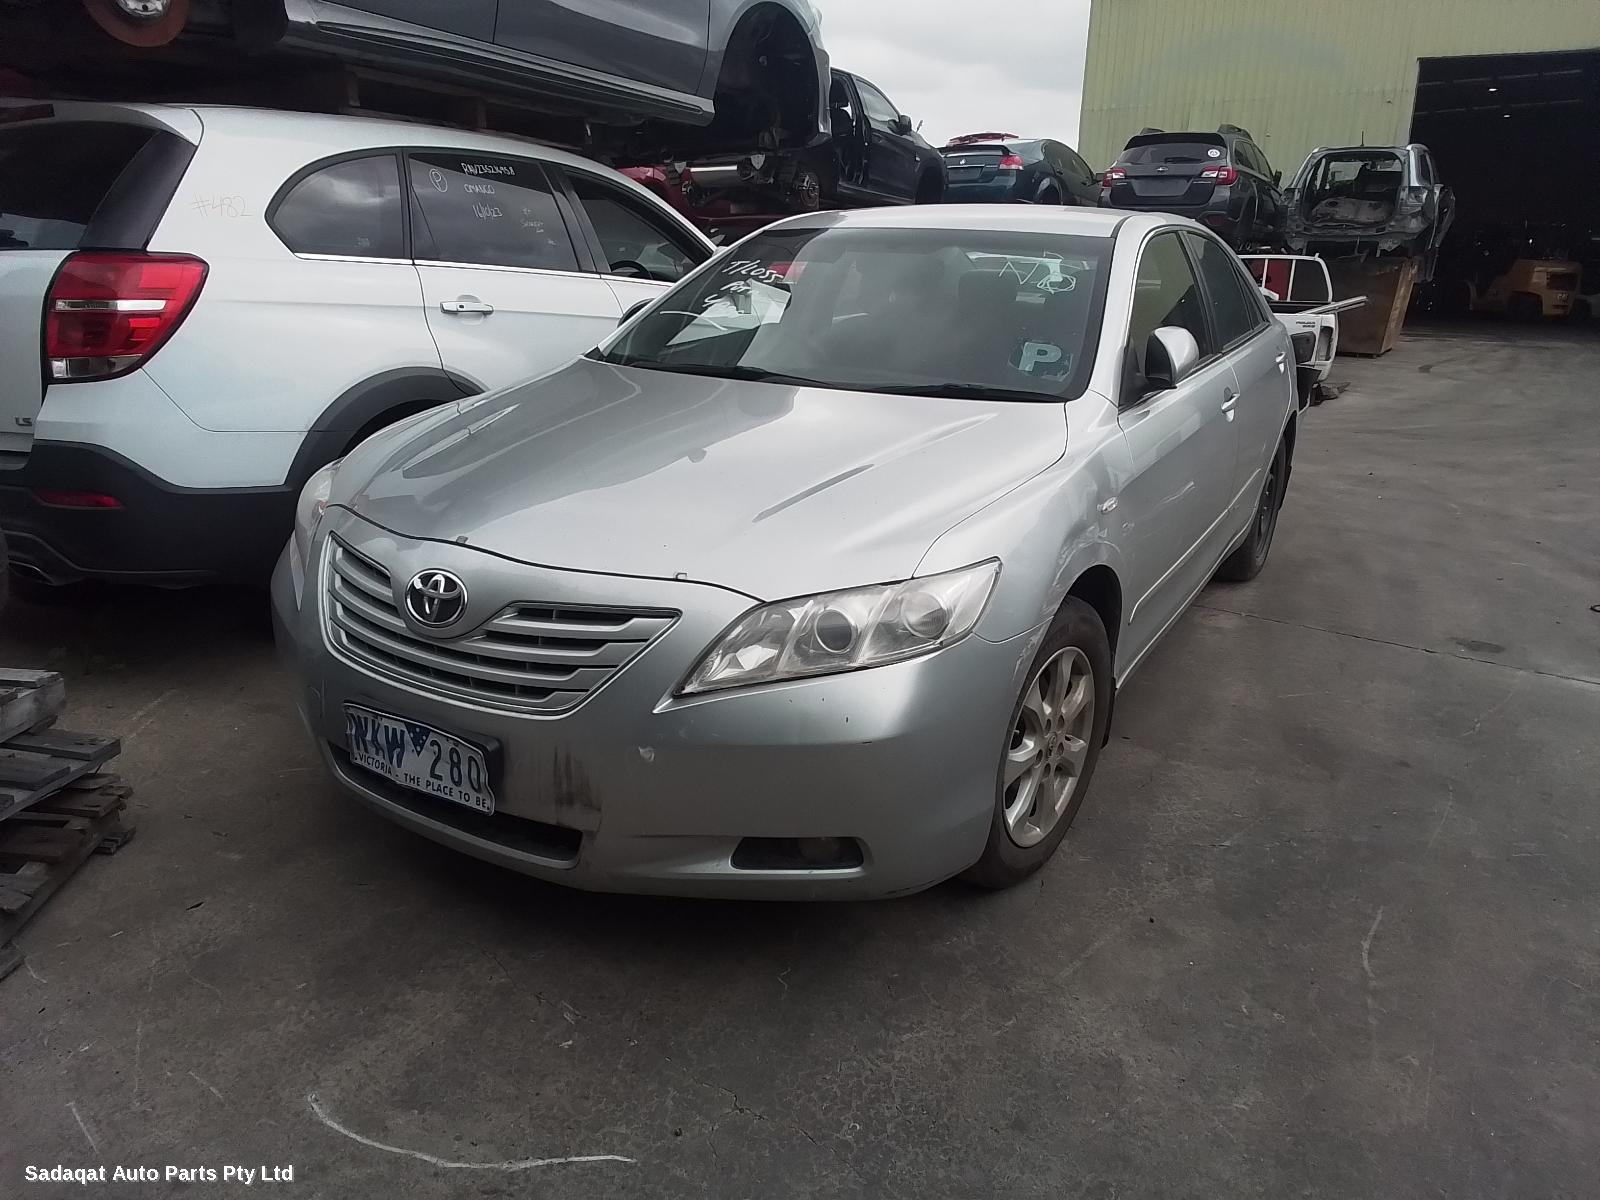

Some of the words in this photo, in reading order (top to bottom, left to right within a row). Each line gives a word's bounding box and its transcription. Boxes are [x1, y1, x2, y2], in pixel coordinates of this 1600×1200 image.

[1019, 342, 1062, 371] P
[358, 752, 392, 776] VICTORIA
[404, 773, 421, 787] THE
[426, 780, 453, 797] PLACE
[458, 790, 471, 803] TO
[430, 740, 482, 793] 280
